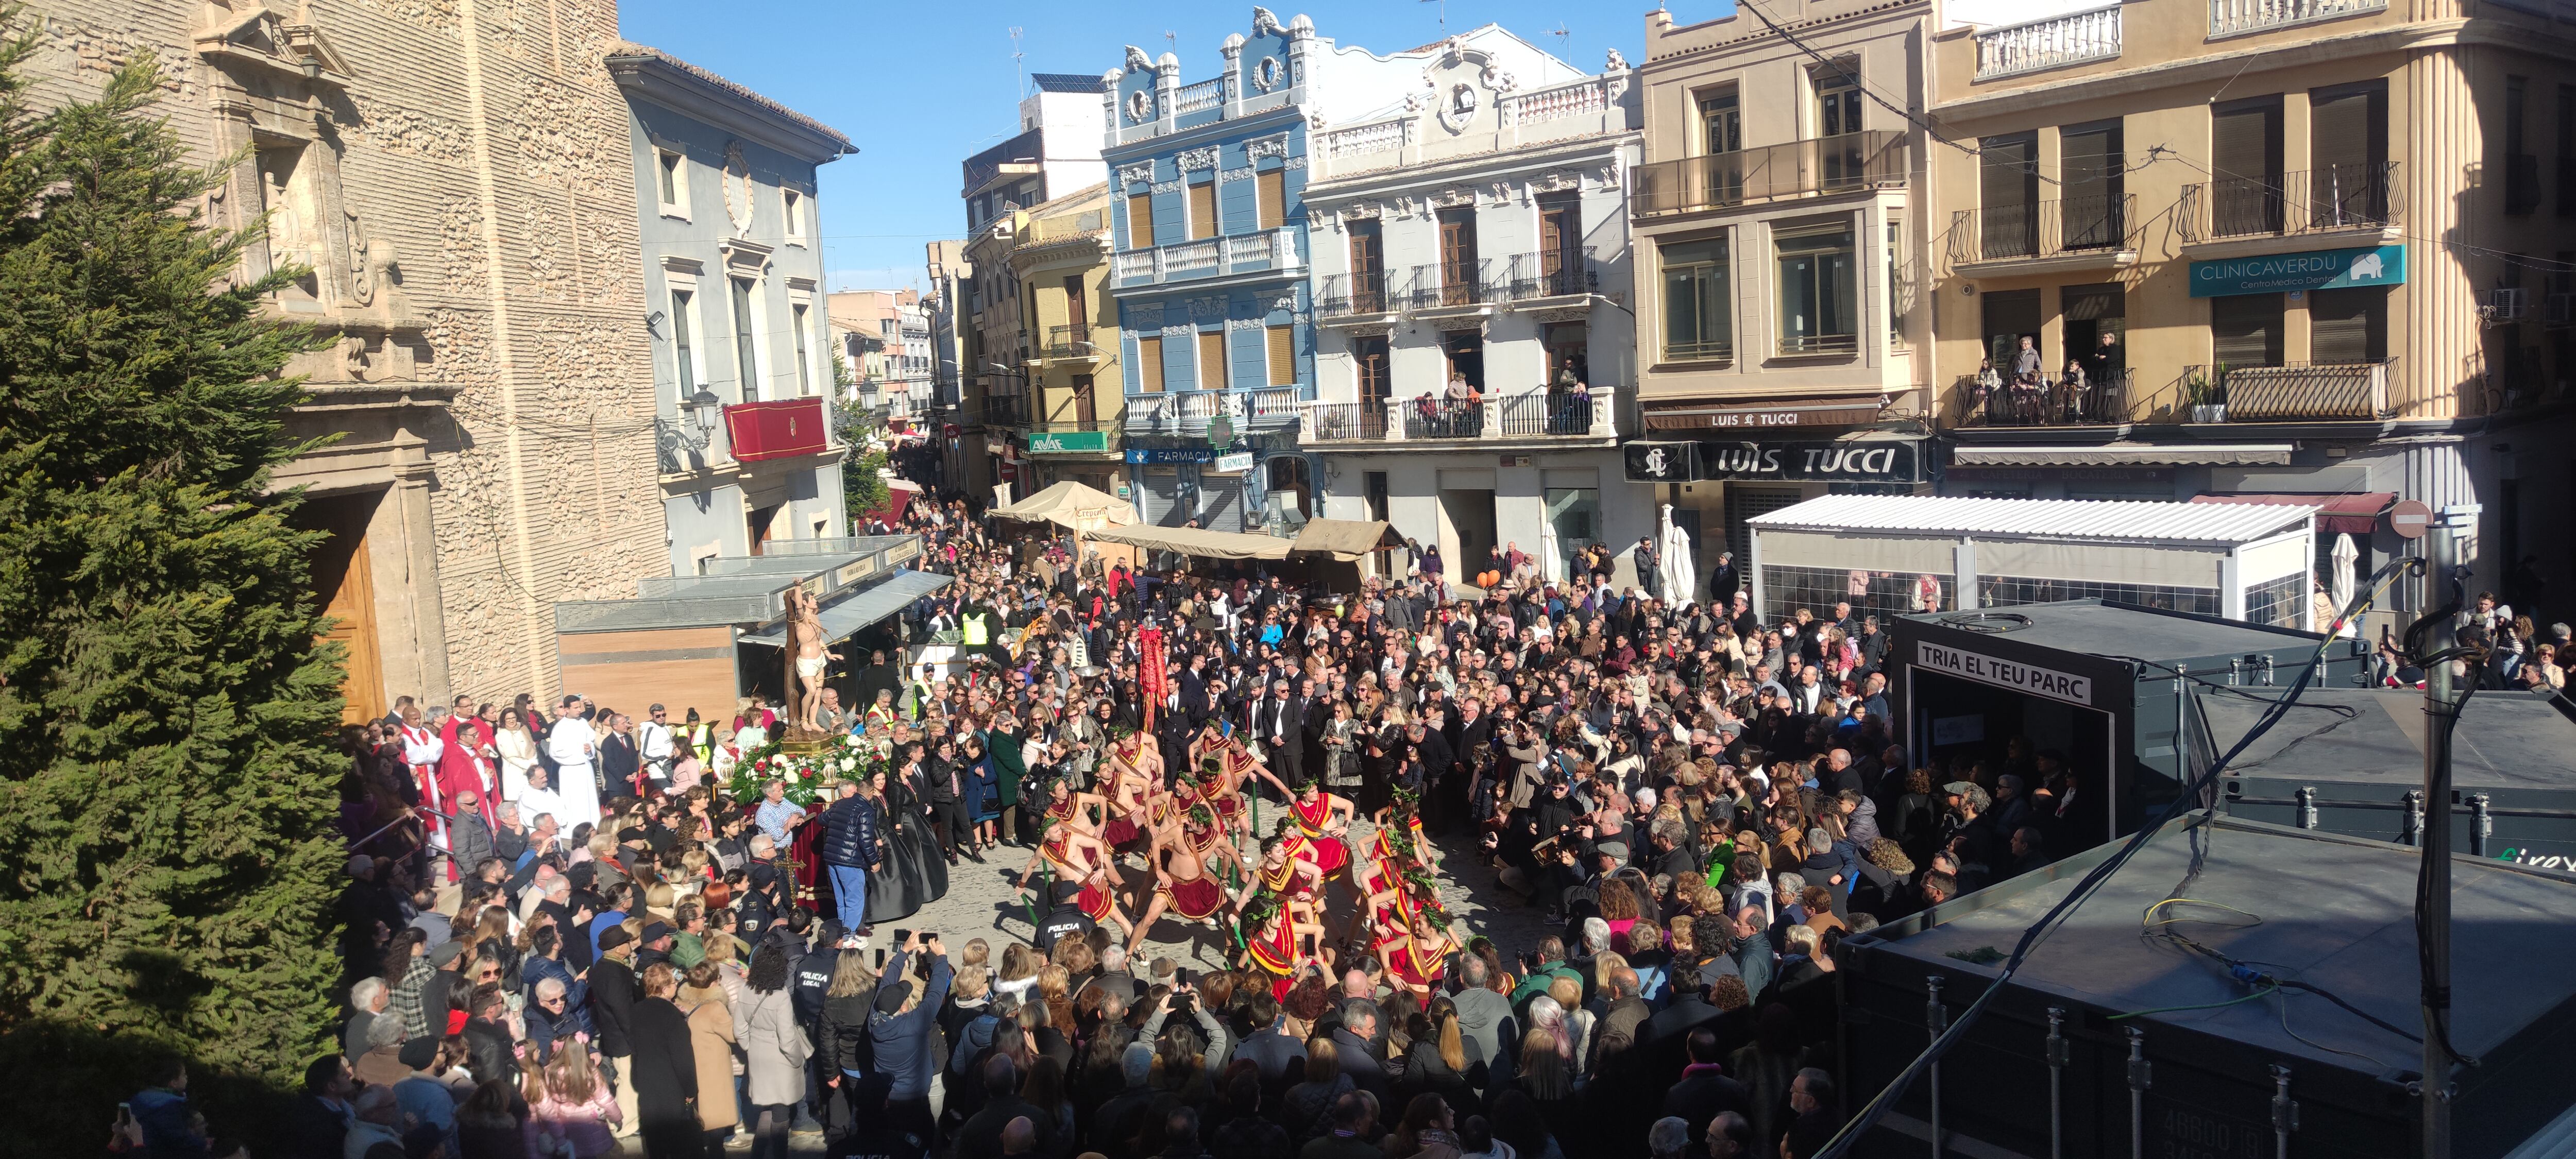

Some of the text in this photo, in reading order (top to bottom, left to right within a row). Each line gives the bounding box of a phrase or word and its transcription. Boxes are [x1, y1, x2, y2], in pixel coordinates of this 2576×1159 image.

[2306, 275, 2336, 284] Dental
[1713, 415, 1738, 425] LUIS
[1760, 414, 1798, 425] TUCCI
[1158, 451, 1212, 462] FARMACIA
[1719, 449, 1895, 473] LUIS TUCCI
[1219, 456, 1251, 469] FARMACIA
[1922, 646, 2083, 699] TRIA EL TEU PARC
[1048, 923, 1079, 933] POLICIA
[800, 971, 827, 982] POLICIA
